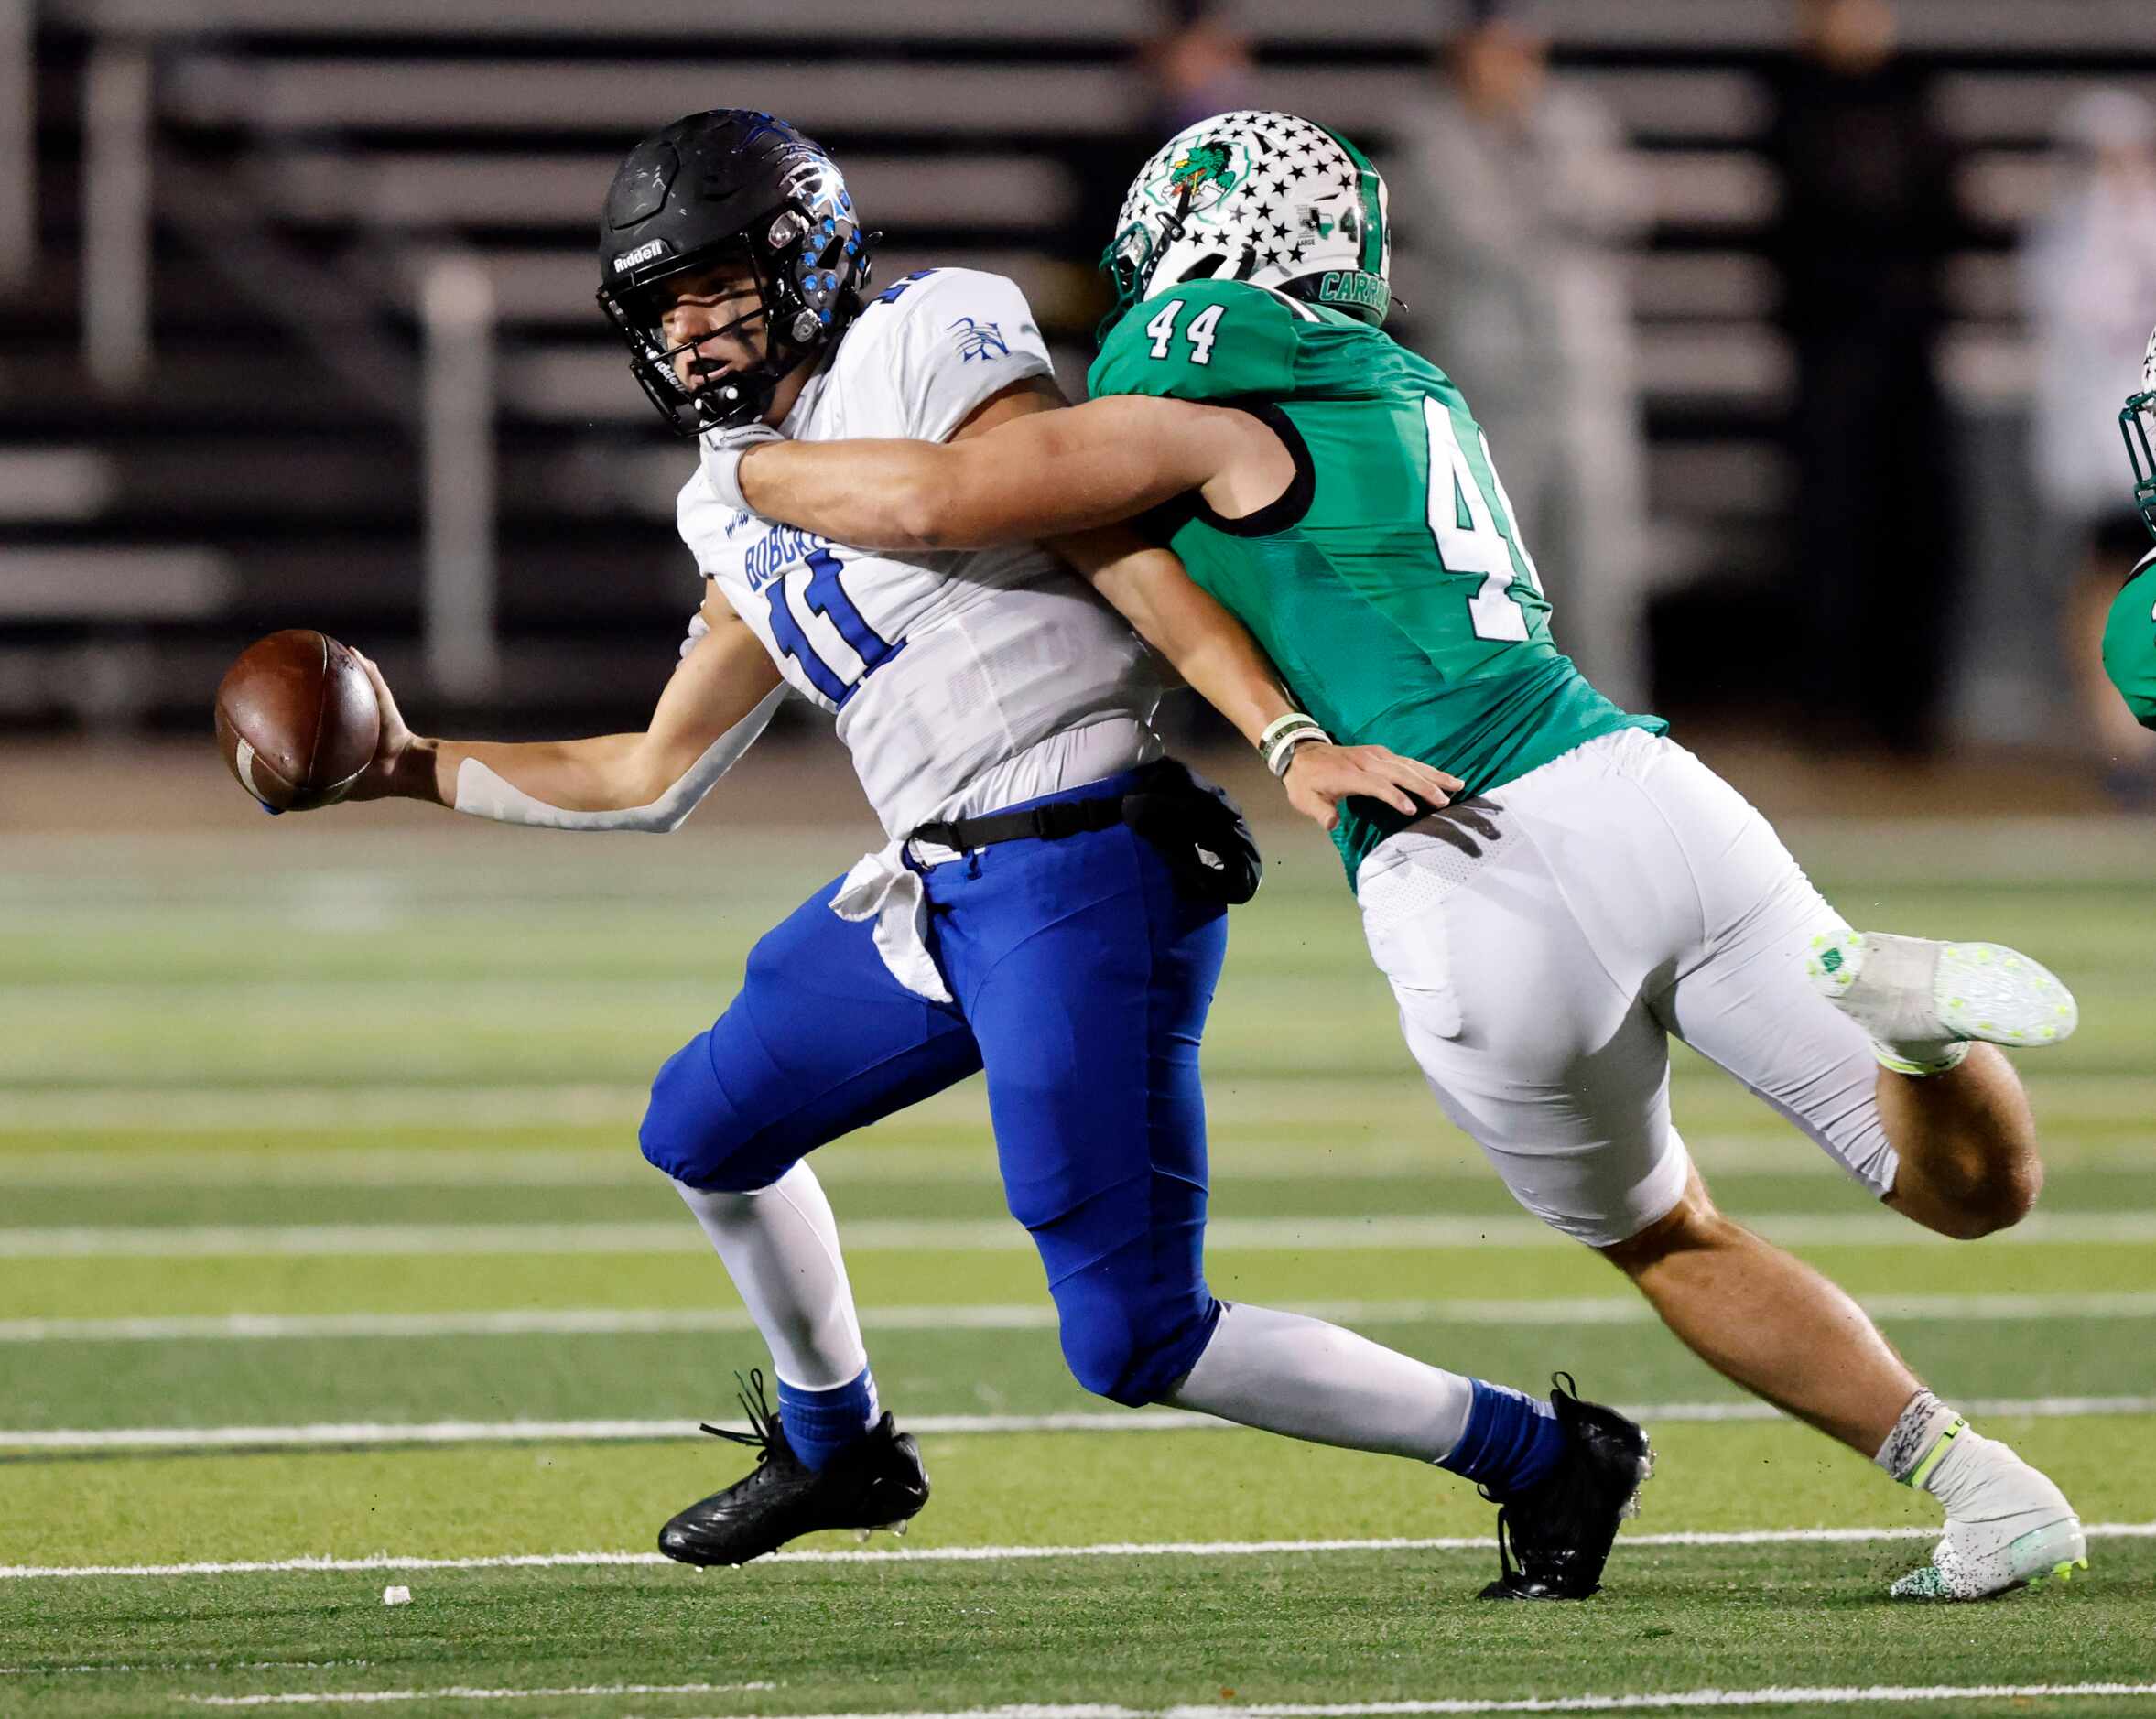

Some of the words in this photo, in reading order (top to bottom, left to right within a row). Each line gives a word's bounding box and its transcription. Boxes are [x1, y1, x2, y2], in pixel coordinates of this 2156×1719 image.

[614, 241, 663, 273] Riddell
[1145, 299, 1228, 365] 44
[765, 547, 908, 712] 11
